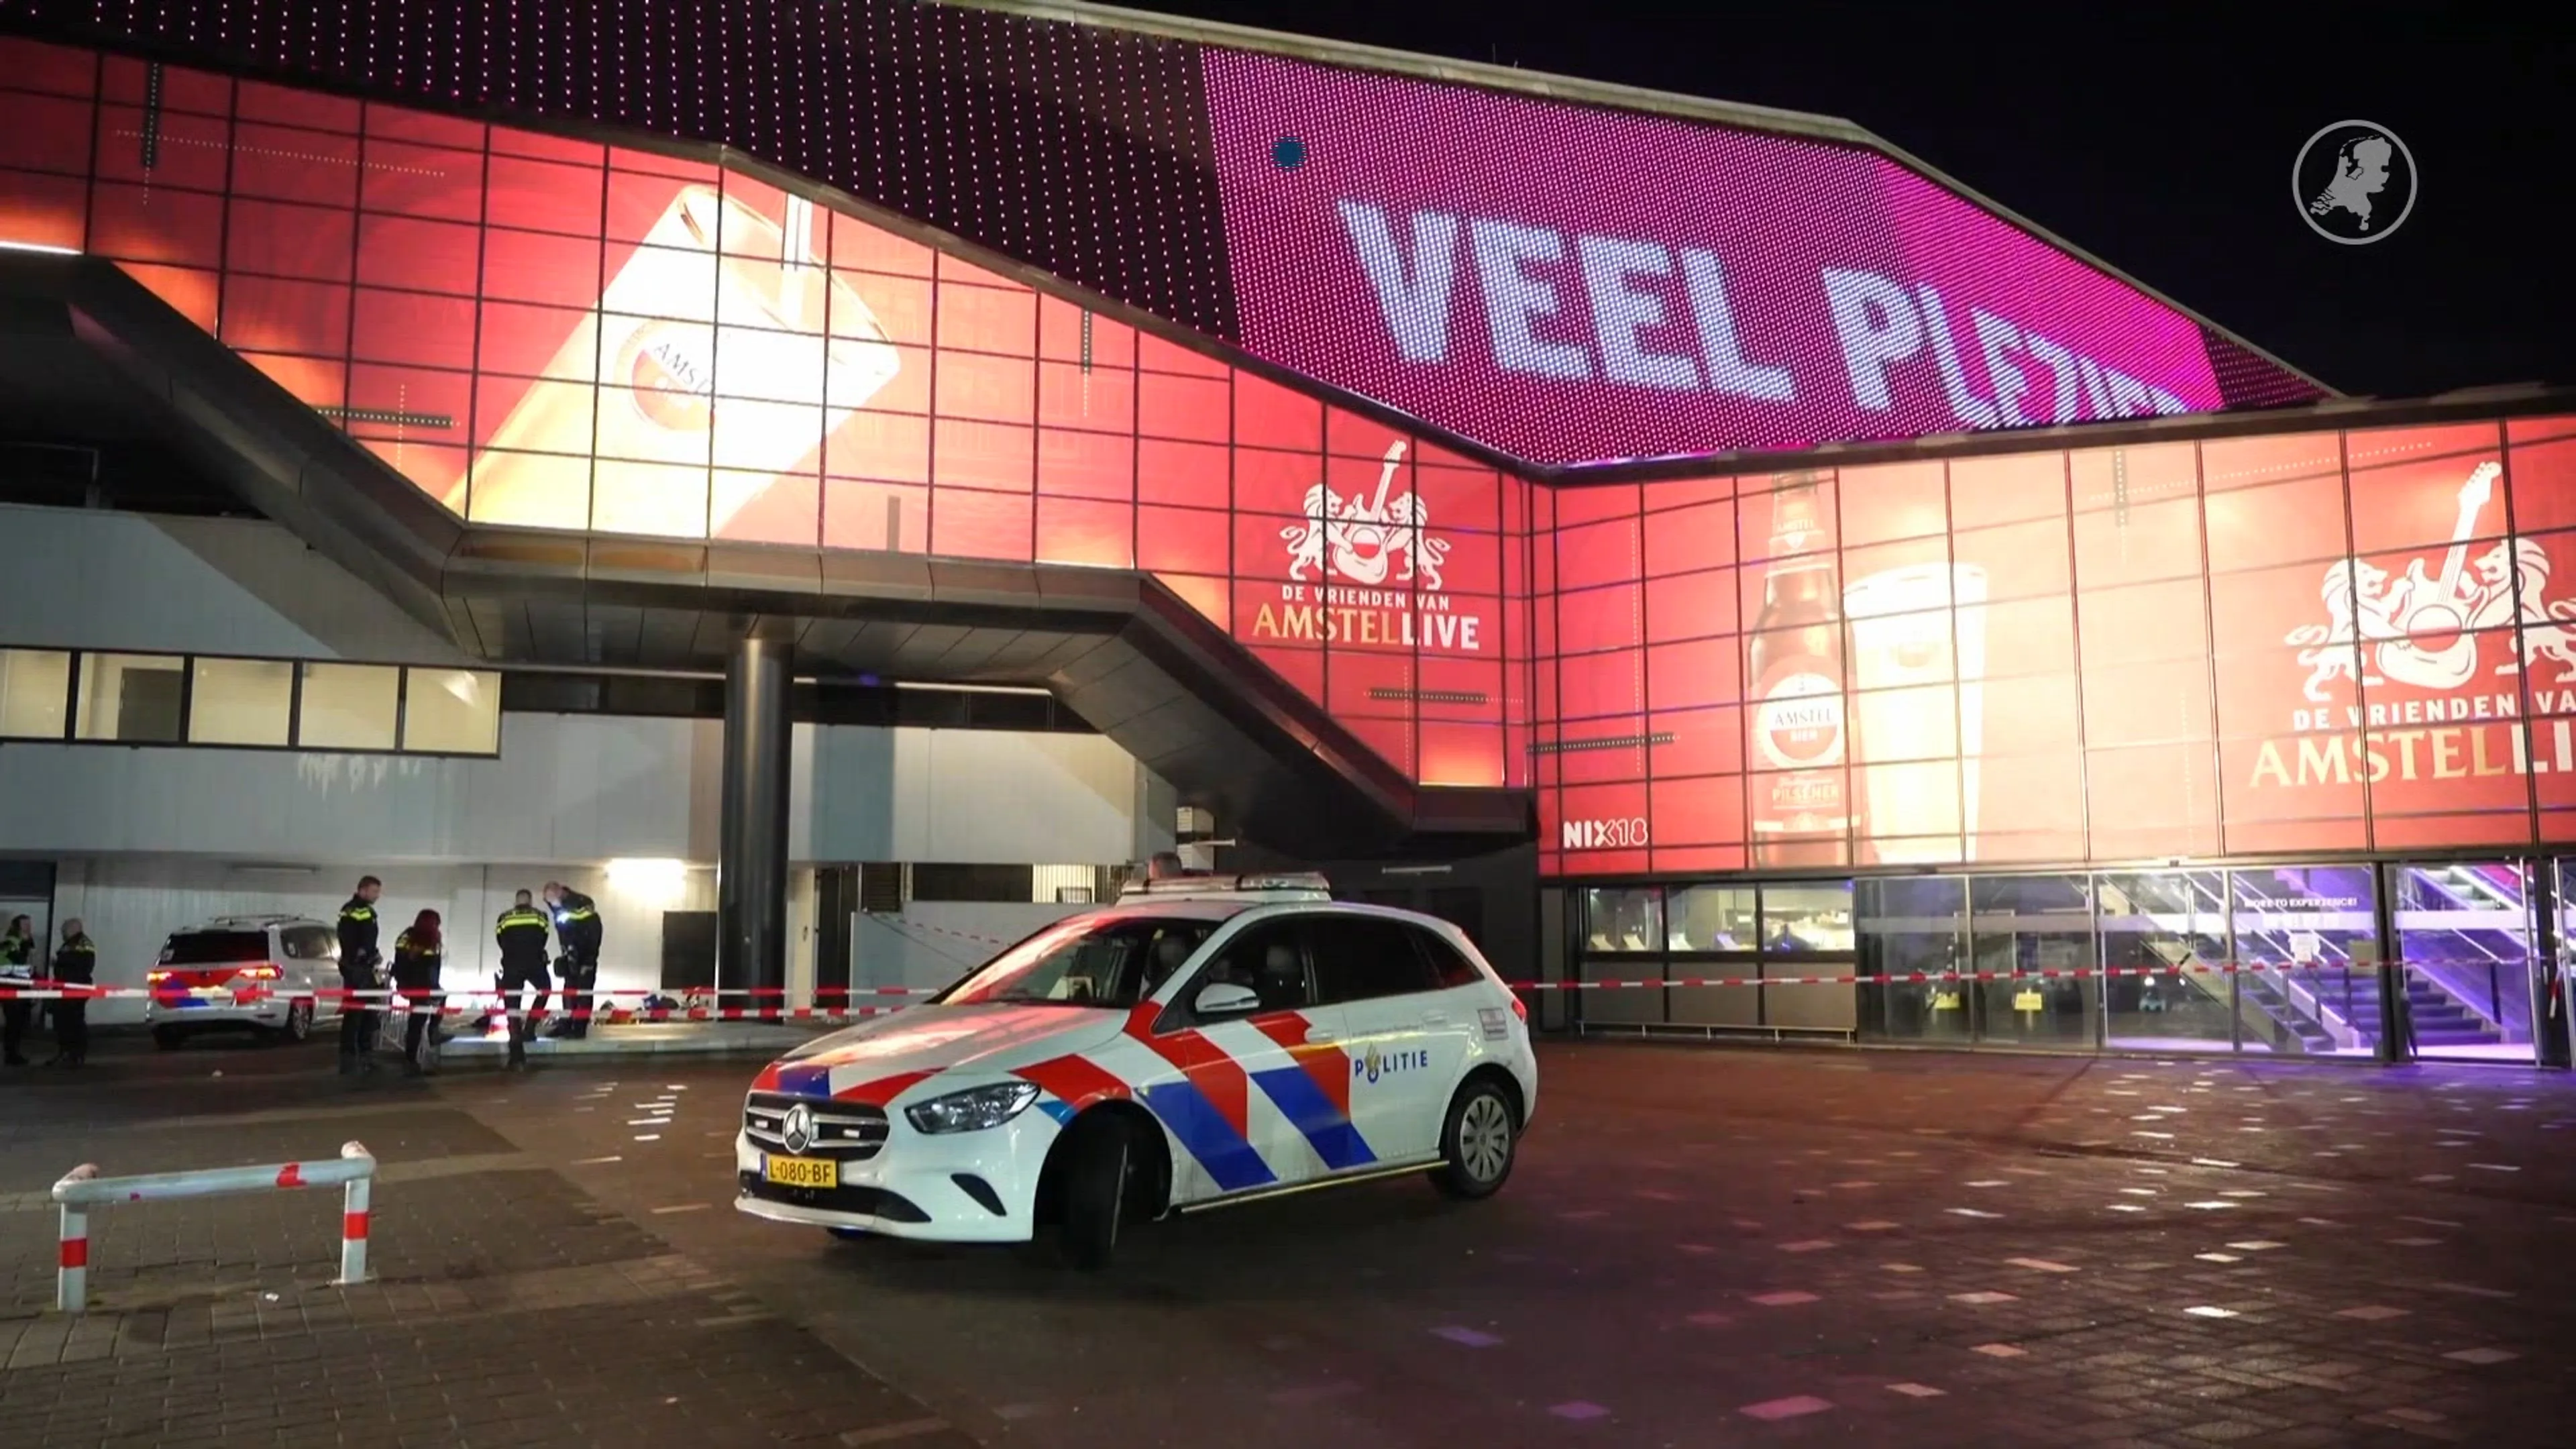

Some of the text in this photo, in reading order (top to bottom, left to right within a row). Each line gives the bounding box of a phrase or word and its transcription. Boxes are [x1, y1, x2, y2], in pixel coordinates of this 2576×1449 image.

[1336, 197, 1797, 404] VEEL
[1282, 584, 1449, 612] DE VRIENDEN VAN
[1775, 708, 1833, 727] AMSTEL
[2293, 708, 2331, 731] DE
[2346, 693, 2517, 729] VRIENDEN
[1563, 817, 1648, 849] NIX18
[1354, 1049, 1428, 1083] POLITIE
[769, 1159, 831, 1183] L-080-BF
